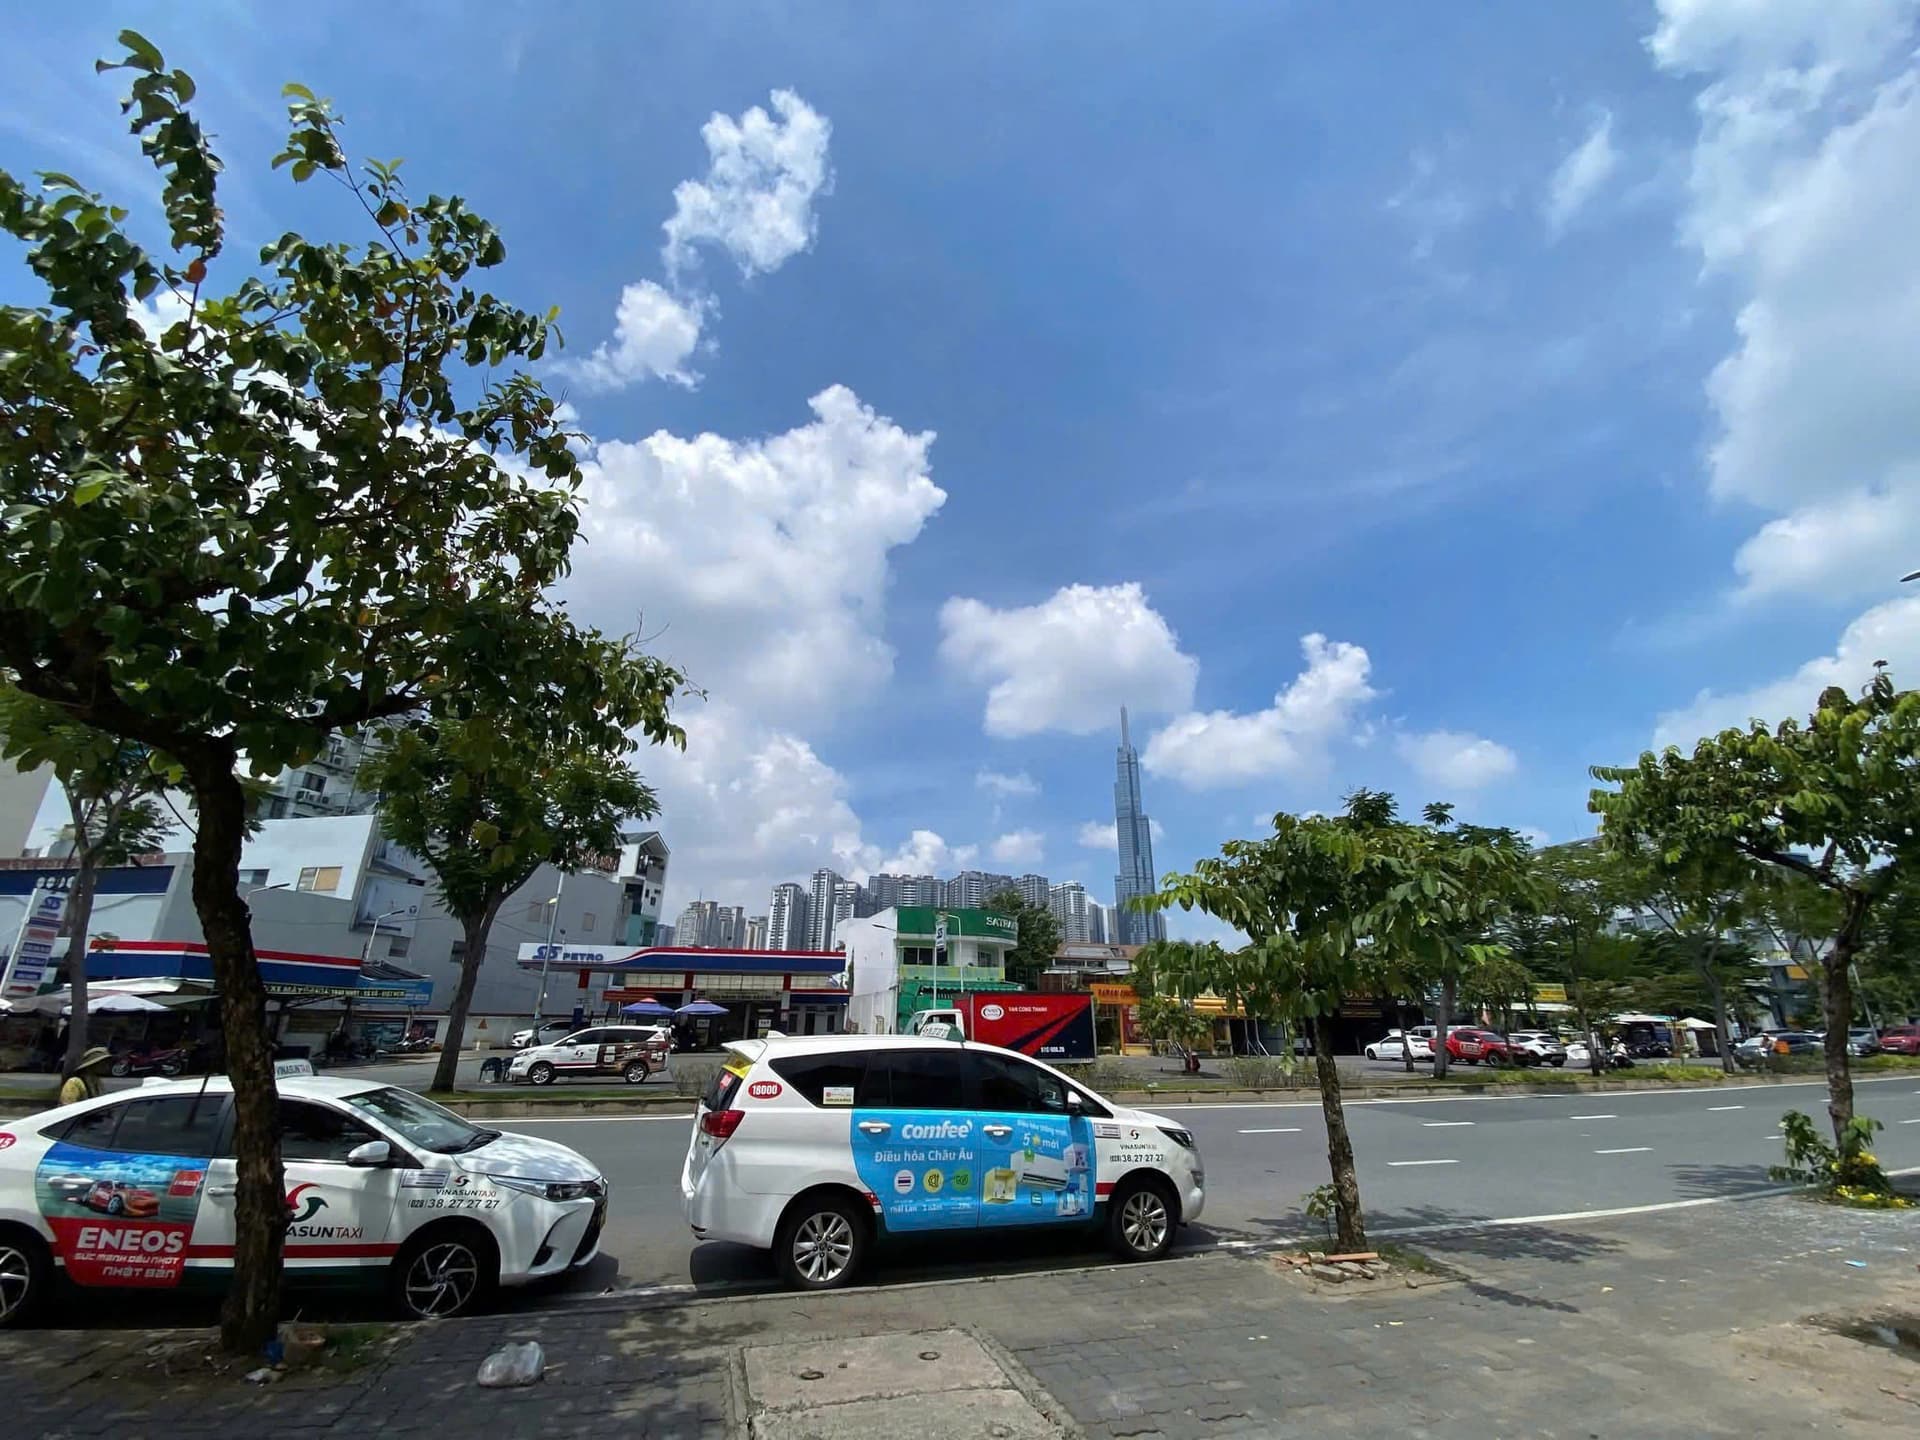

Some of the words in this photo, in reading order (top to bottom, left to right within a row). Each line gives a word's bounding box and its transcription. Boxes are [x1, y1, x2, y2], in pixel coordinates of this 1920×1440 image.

[562, 952, 604, 961] PETRO
[1022, 1132, 1031, 1147] 5
[436, 1189, 497, 1197] VINASUNTAXI
[284, 1226, 363, 1239] ASUNTAXI
[76, 1226, 184, 1253] ENEOS
